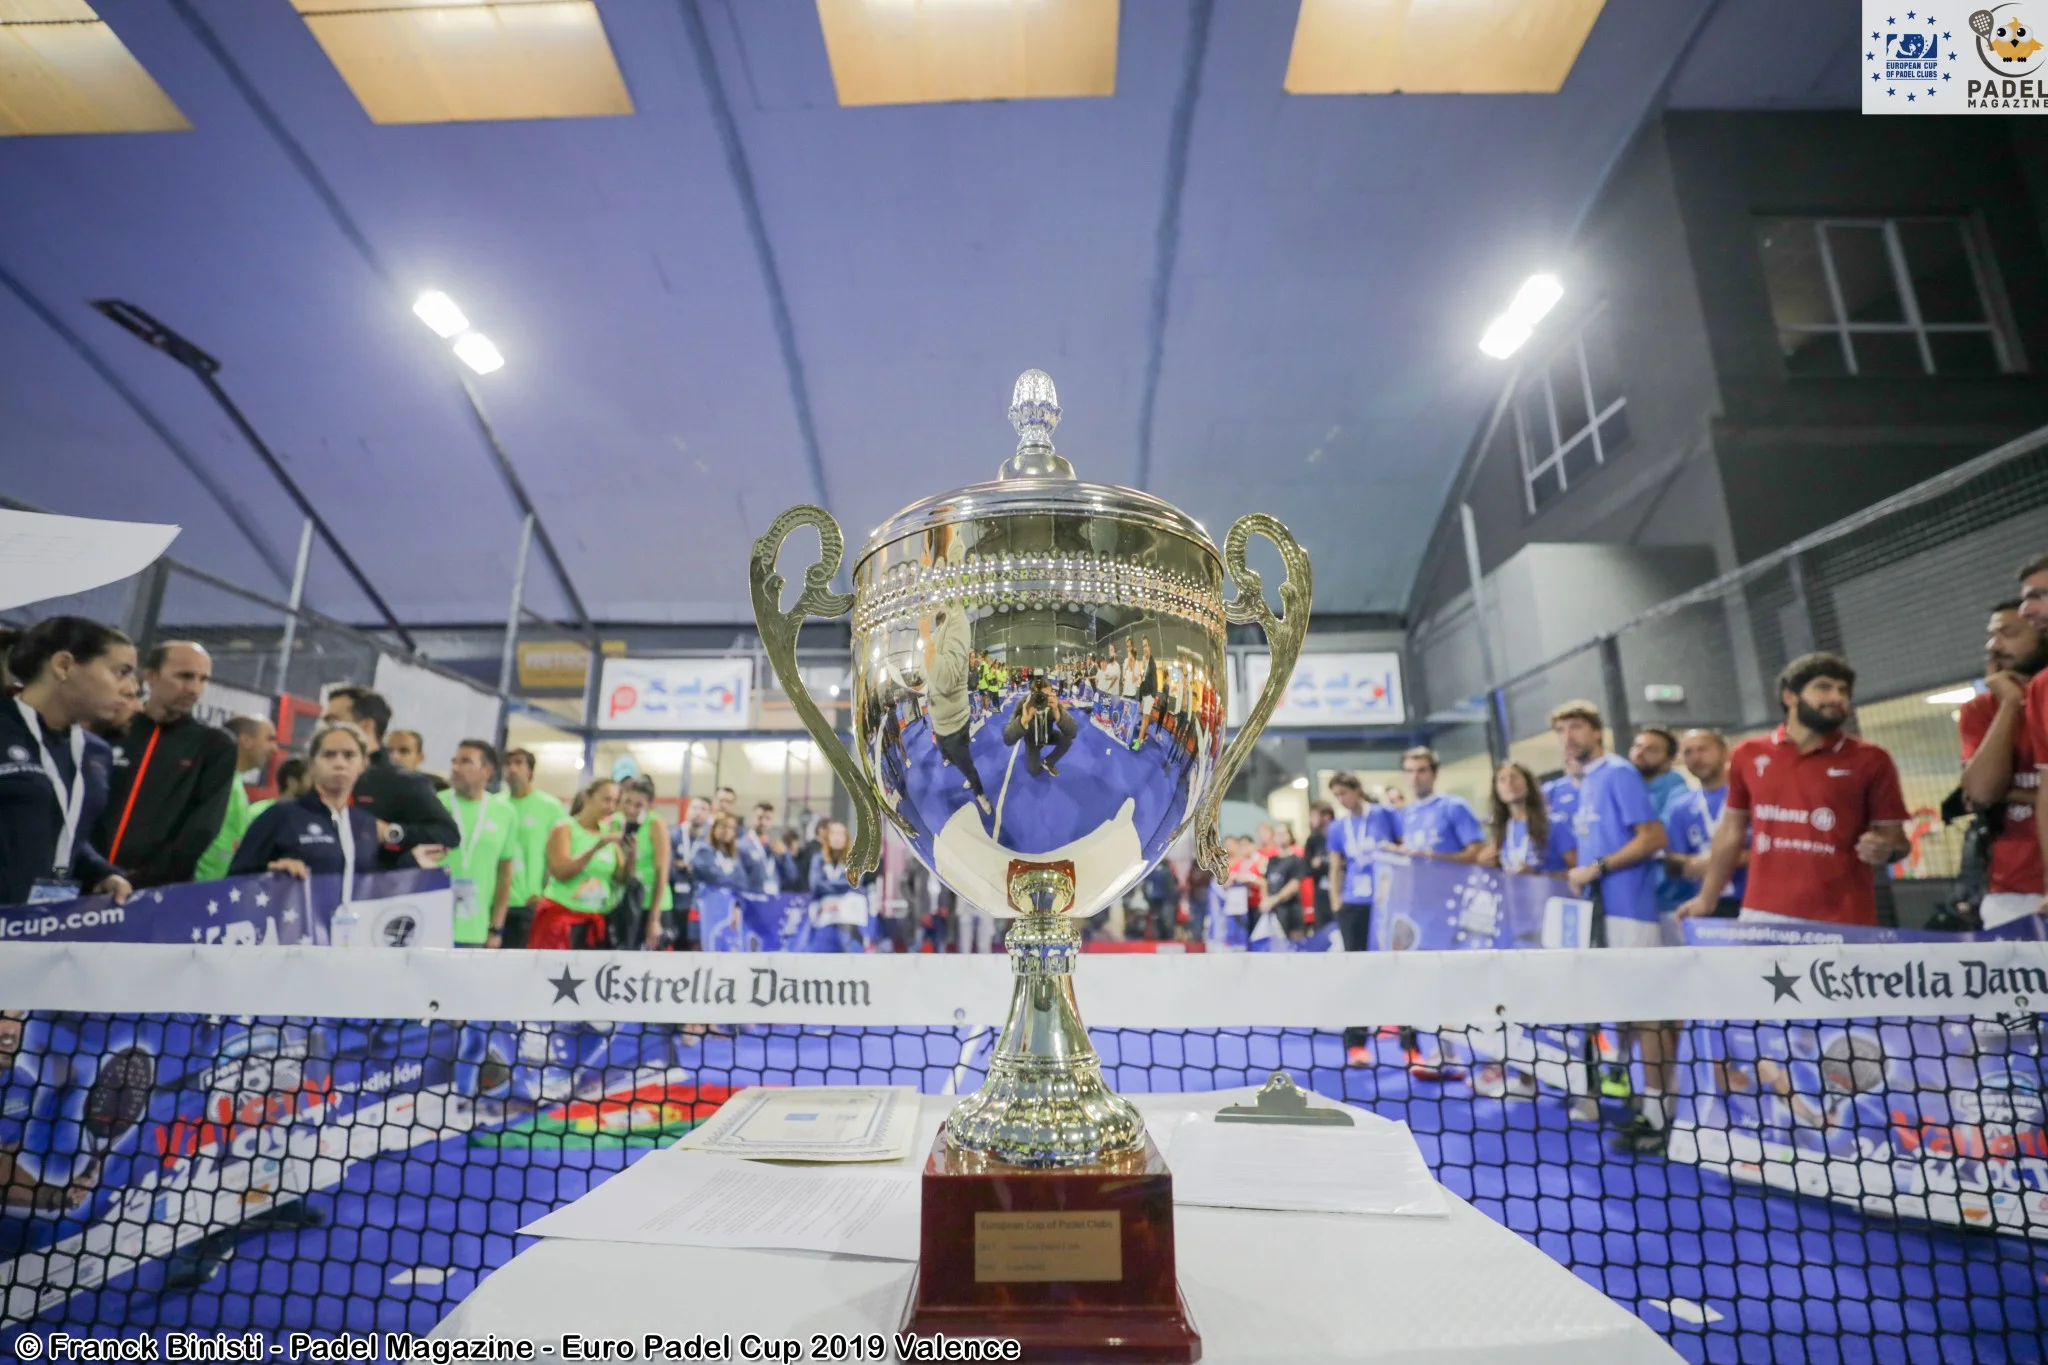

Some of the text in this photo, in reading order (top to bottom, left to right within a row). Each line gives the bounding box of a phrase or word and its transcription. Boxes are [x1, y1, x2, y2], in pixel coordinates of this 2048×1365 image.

[594, 961, 873, 1008] Estrella Damm
[1810, 957, 1955, 1002] Estrella
[980, 1219, 1024, 1231] European
[1026, 1219, 1045, 1231] Cup
[1047, 1219, 1056, 1230] of
[1058, 1218, 1085, 1230] Padel
